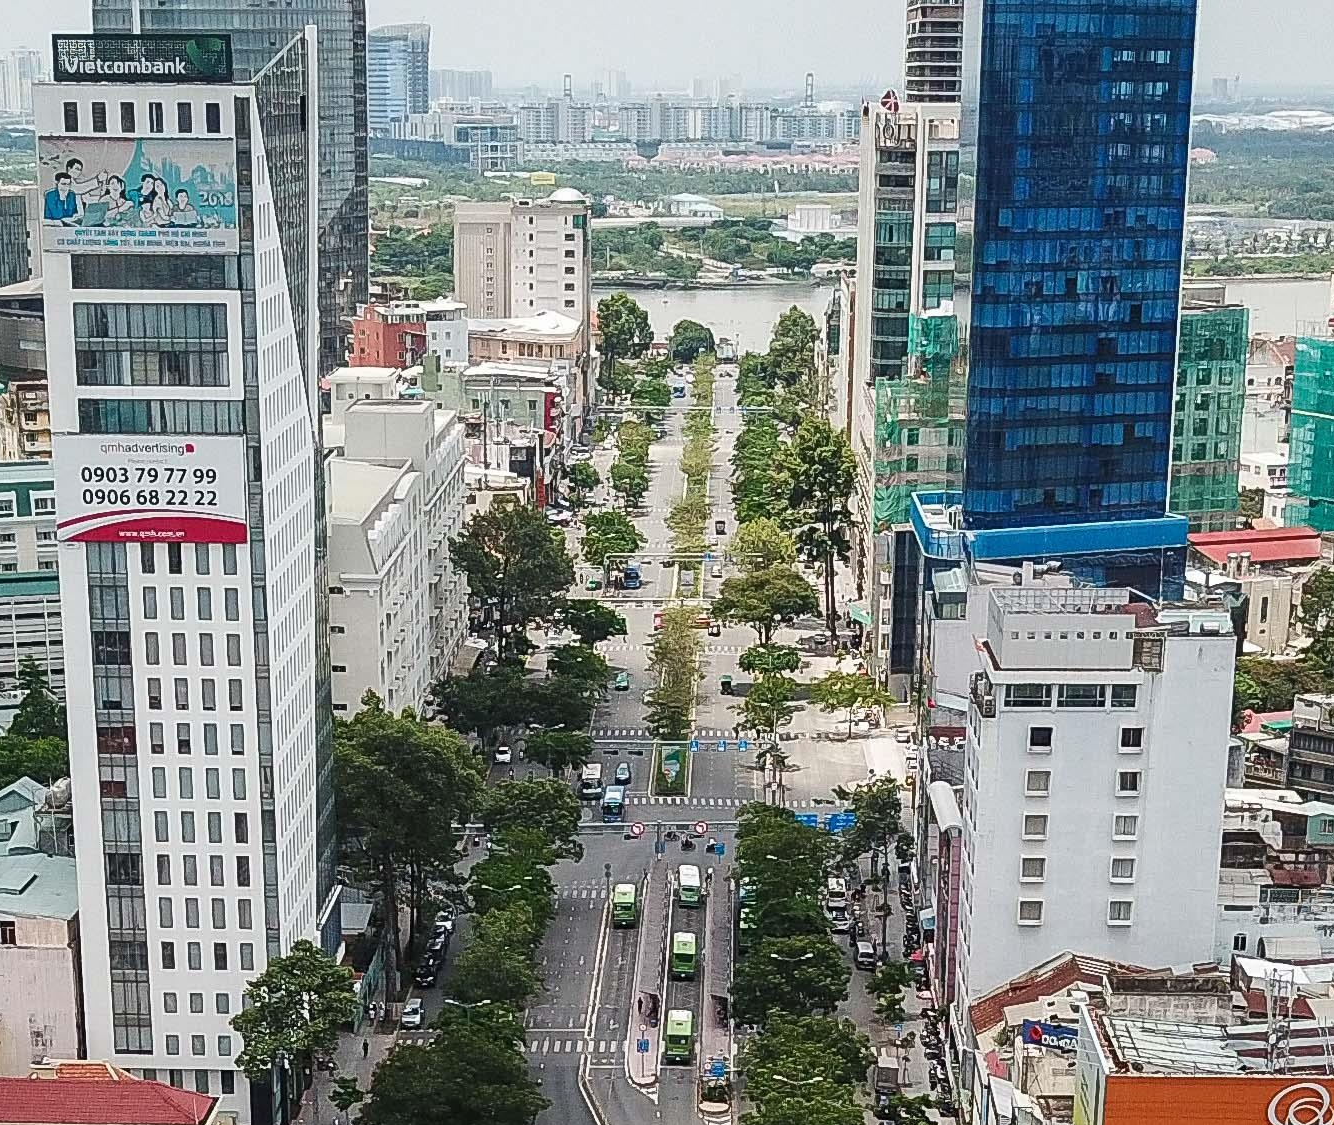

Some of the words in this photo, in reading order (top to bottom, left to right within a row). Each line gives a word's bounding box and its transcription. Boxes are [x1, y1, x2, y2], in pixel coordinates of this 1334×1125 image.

[67, 57, 187, 75] Vietcombank
[199, 191, 234, 207] 2018
[101, 442, 185, 457] qmhadvertising
[81, 466, 129, 483] 0903
[135, 467, 159, 483] 79
[163, 467, 187, 484] 77
[193, 468, 217, 484] 99
[82, 488, 131, 505] 0906
[136, 489, 160, 506] 68
[166, 490, 189, 506] 22
[194, 490, 218, 506] 22
